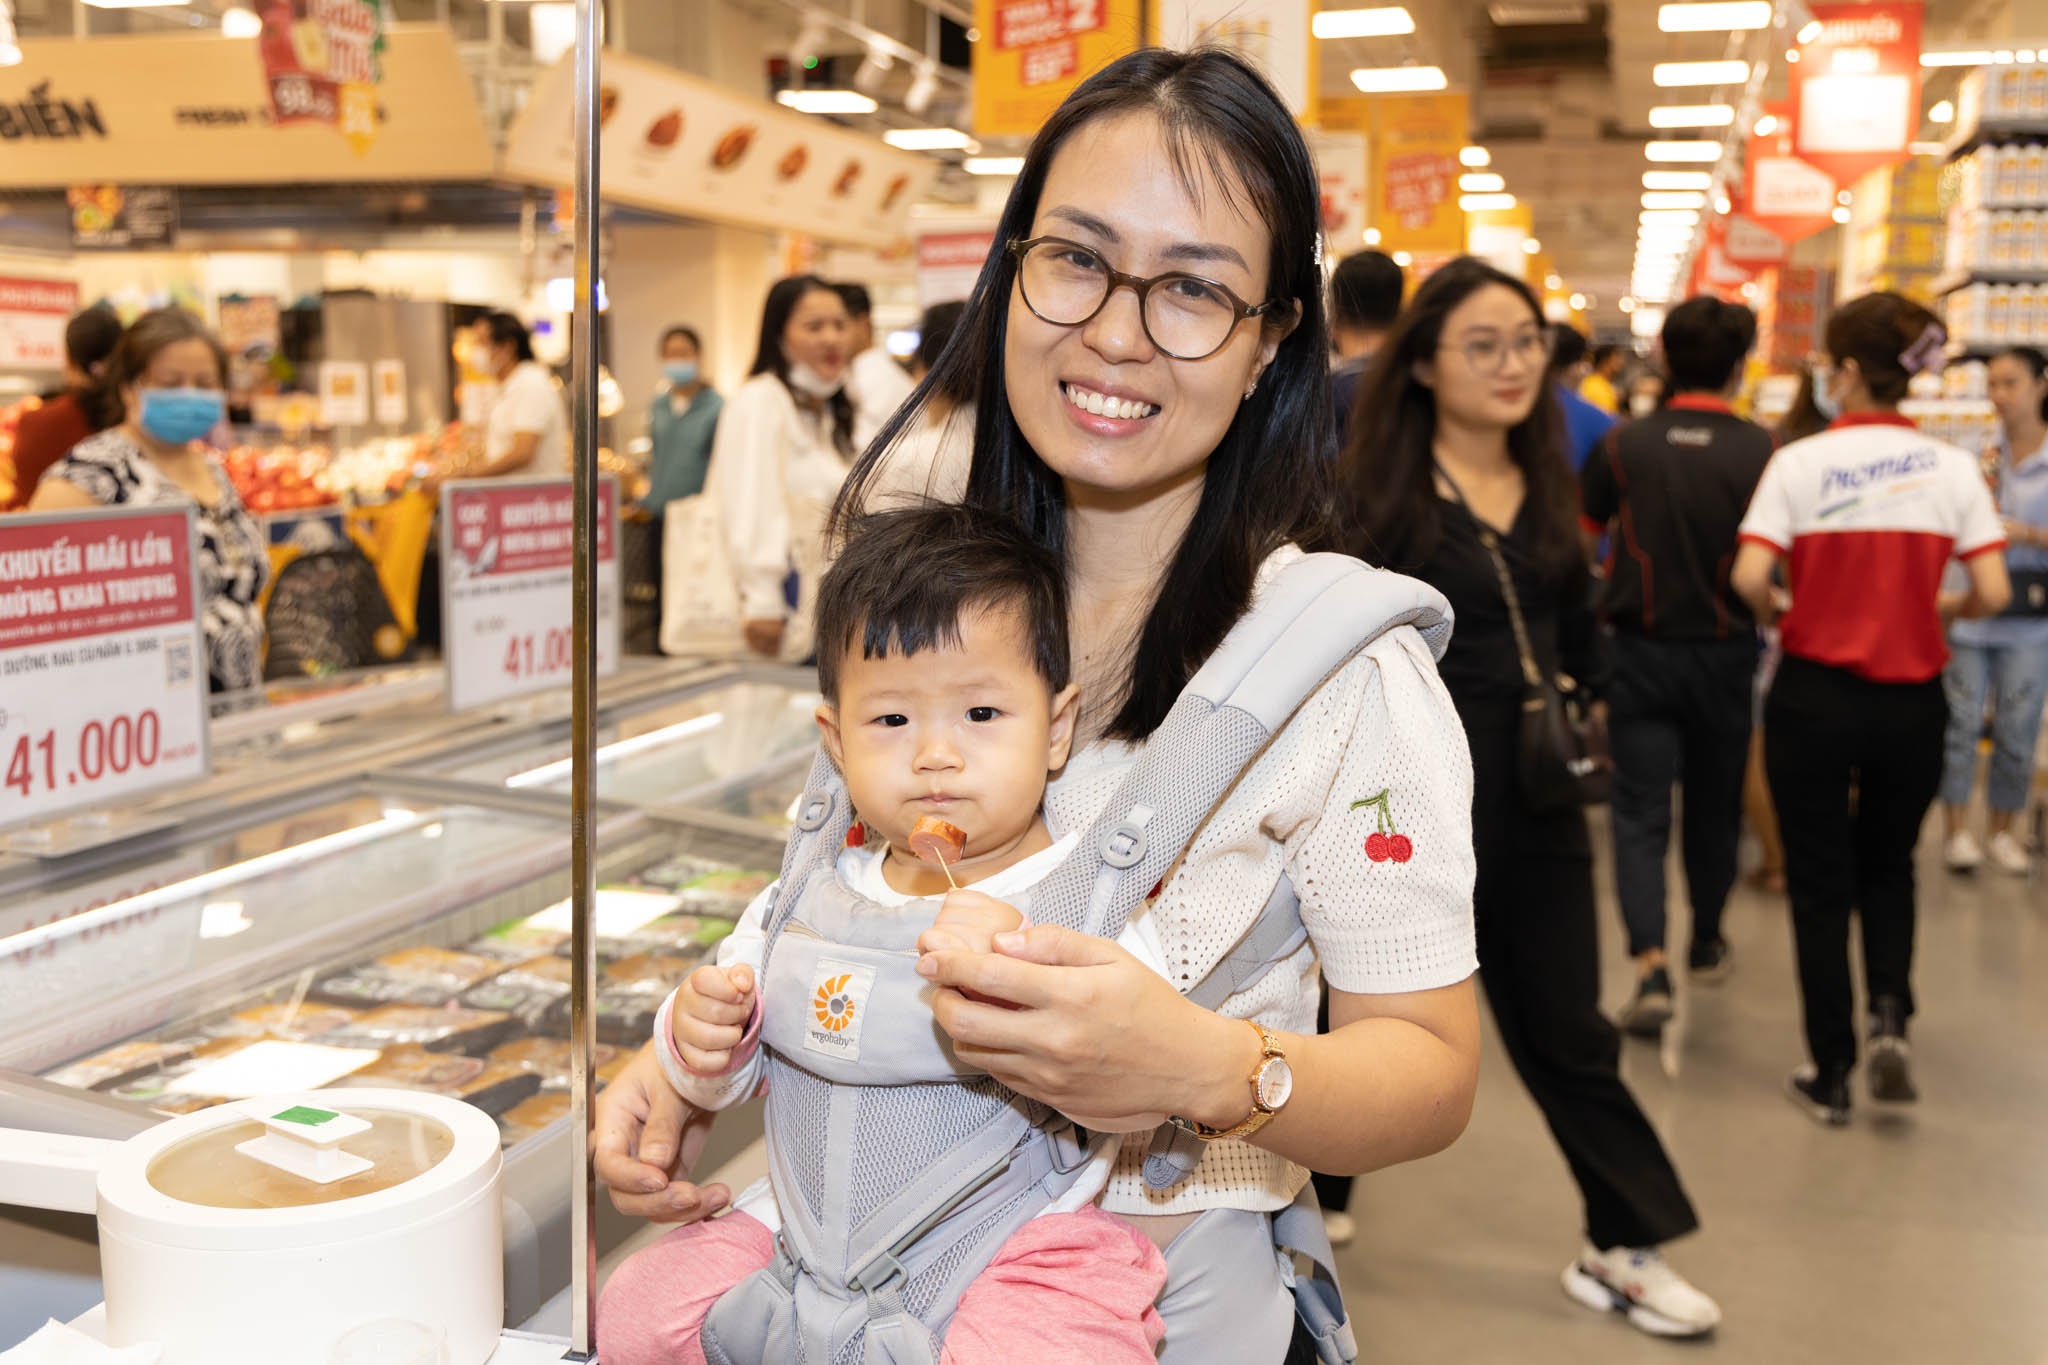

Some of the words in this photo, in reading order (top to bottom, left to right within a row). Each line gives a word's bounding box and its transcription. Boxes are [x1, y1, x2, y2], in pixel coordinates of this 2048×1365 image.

[131, 531, 173, 568] LỚN
[59, 582, 105, 612] KHAI
[5, 708, 160, 796] 41.000
